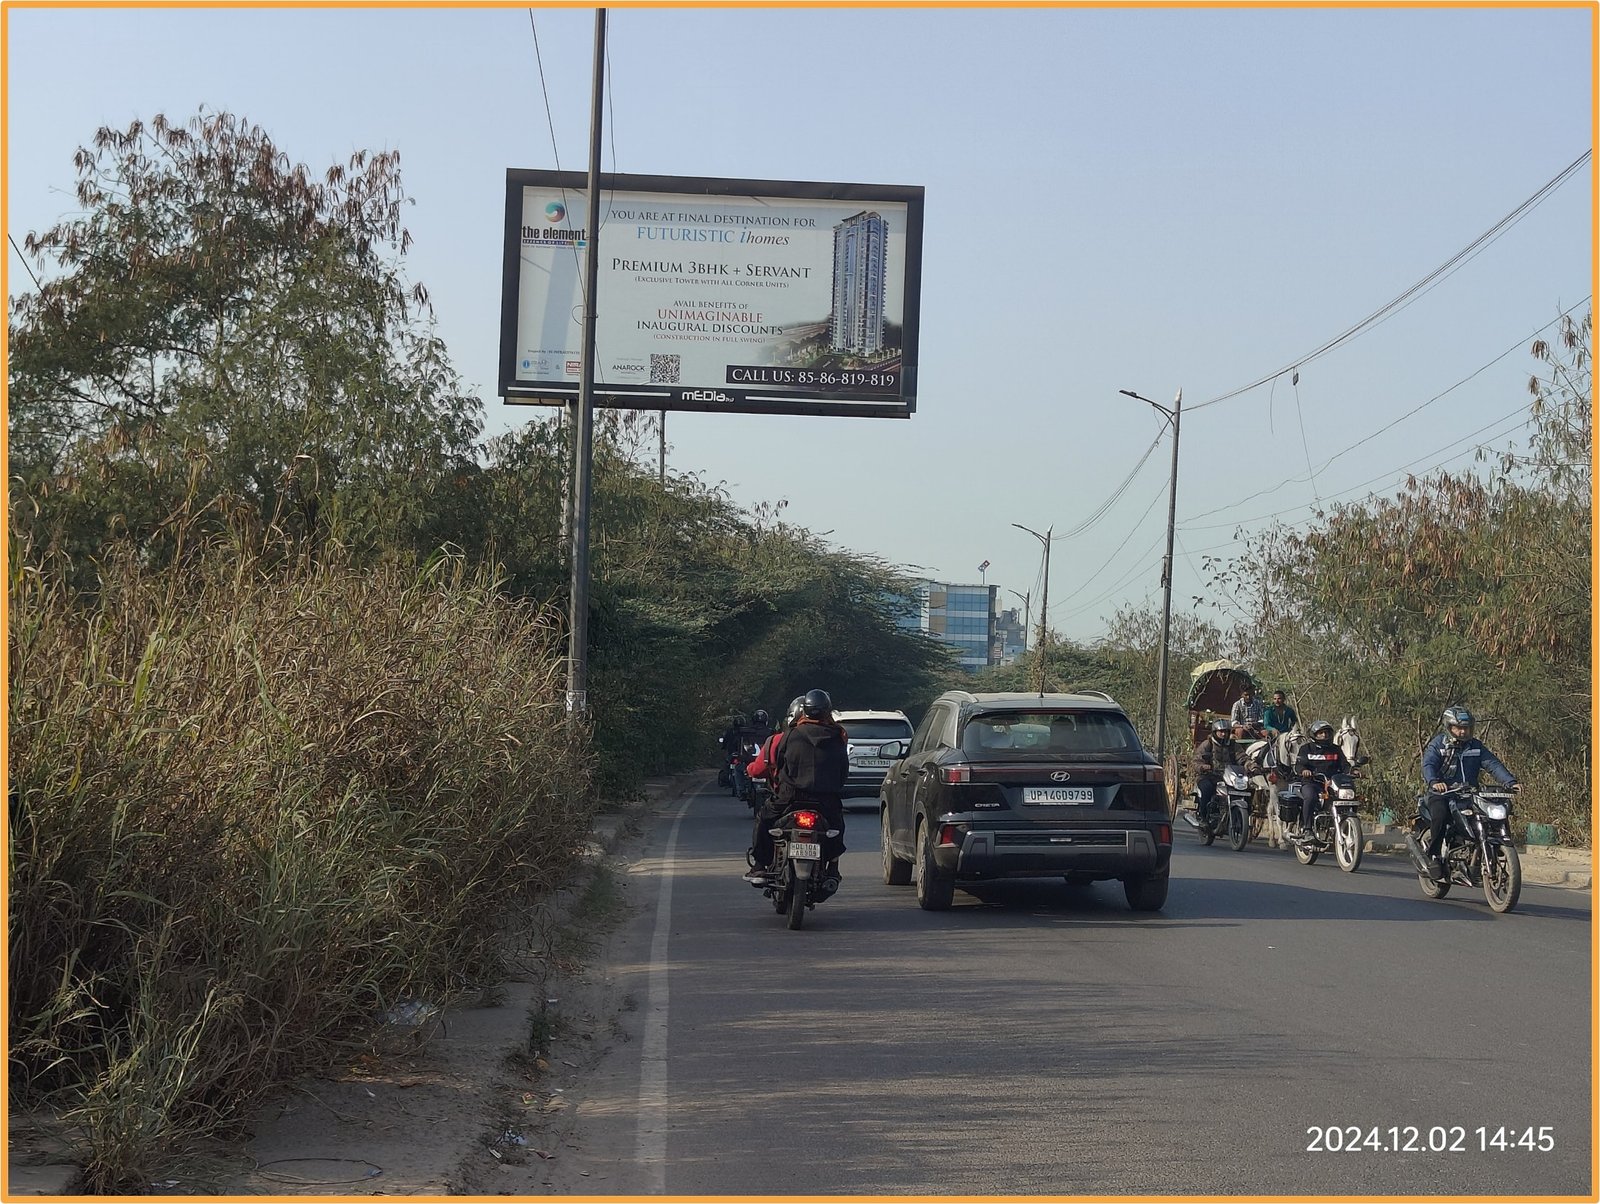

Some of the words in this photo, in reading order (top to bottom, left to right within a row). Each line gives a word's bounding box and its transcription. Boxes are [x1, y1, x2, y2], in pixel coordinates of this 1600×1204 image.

[612, 209, 635, 221] YOU
[639, 212, 660, 222] ARE
[662, 213, 676, 222] AT
[679, 213, 710, 224] FINAL
[714, 215, 790, 226] DESTINATION
[794, 218, 816, 228] FOR
[523, 226, 540, 238] the
[543, 227, 586, 240] element
[637, 226, 735, 243] FUTURISTIC
[740, 226, 790, 246] ihomes
[612, 258, 683, 274] PREMIUM
[688, 262, 729, 276] 3BHK
[733, 268, 741, 276] +
[746, 264, 812, 279] SERVANT
[673, 300, 696, 308] AVAIL
[698, 302, 736, 310] BENEFITS
[658, 309, 763, 324] UNIMAGINABLE
[637, 321, 708, 333] INAUGURAL
[712, 323, 784, 336] DISCOUNTS
[612, 364, 646, 372] ANAROCK
[732, 369, 768, 382] CALL
[773, 371, 795, 383] US:
[798, 372, 895, 387] 85-86-819-819
[1029, 790, 1093, 801] UP14GD9799
